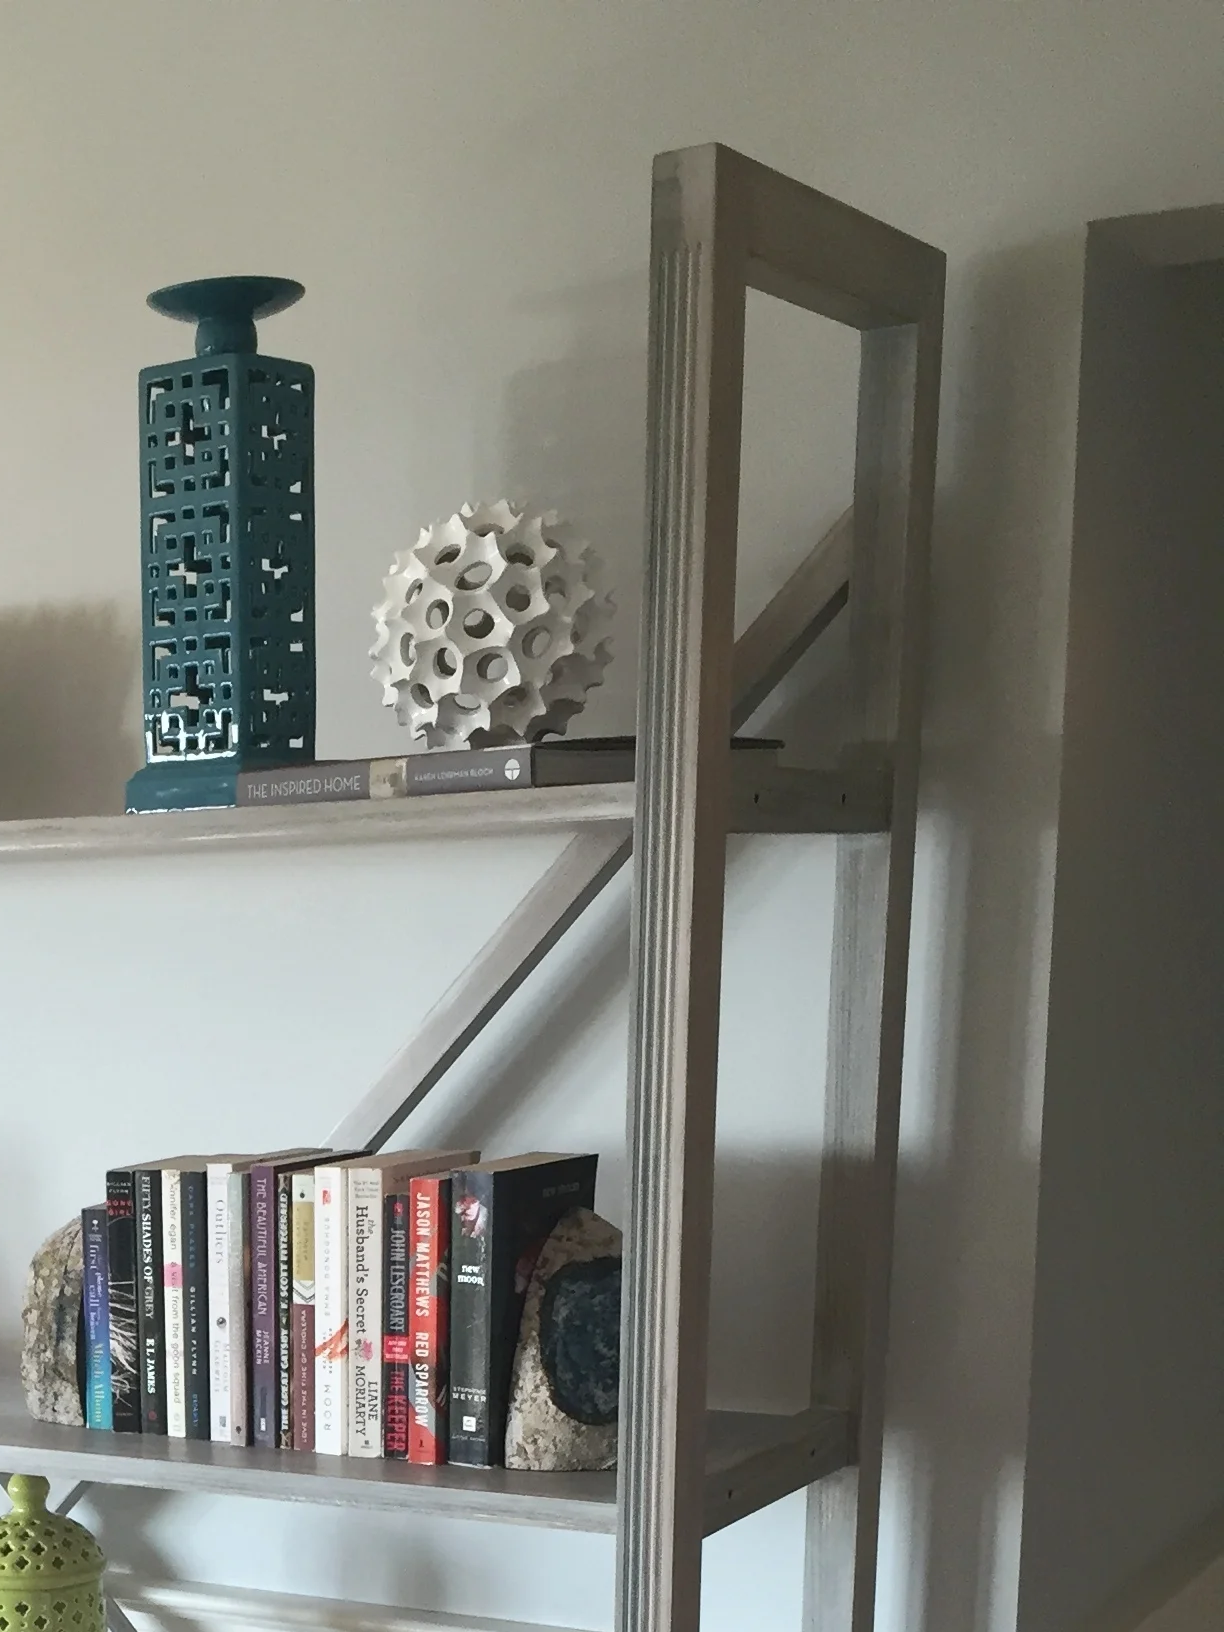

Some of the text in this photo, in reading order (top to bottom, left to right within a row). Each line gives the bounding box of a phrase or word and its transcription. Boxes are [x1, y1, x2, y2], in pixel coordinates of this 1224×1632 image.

[247, 775, 361, 799] THE INSPIRED HOME
[142, 1175, 155, 1319] FIFTY SHADES OF GREY
[170, 1224, 178, 1251] egan
[215, 1199, 227, 1265] Outliers
[256, 1177, 269, 1317] THE BEAUTIFUL AMERICAN
[355, 1204, 369, 1284] Husband's
[367, 1219, 377, 1235] the
[390, 1227, 406, 1261] JOHN
[87, 1244, 99, 1270] first
[415, 1192, 431, 1317] JASON MATTHEWS
[461, 1264, 481, 1274] new
[279, 1263, 289, 1298] SCOTT
[389, 1264, 406, 1333] LESCROART
[457, 1274, 485, 1287] moon
[189, 1285, 198, 1376] GILLIAN FLYNN
[355, 1287, 369, 1334] Secret
[171, 1294, 182, 1404] from the goon squad
[256, 1328, 264, 1365] MACKIN
[145, 1357, 156, 1395] JAMES
[279, 1328, 289, 1431] THE GREAT GATSBY
[391, 1369, 405, 1392] THE
[414, 1332, 430, 1428] RED SPARROW
[300, 1407, 307, 1418] IN
[323, 1383, 333, 1432] ROOM
[355, 1364, 367, 1437] MORIARTY
[367, 1379, 378, 1421] LIANE
[452, 1393, 487, 1404] MEYER
[387, 1393, 407, 1453] KEEPER
